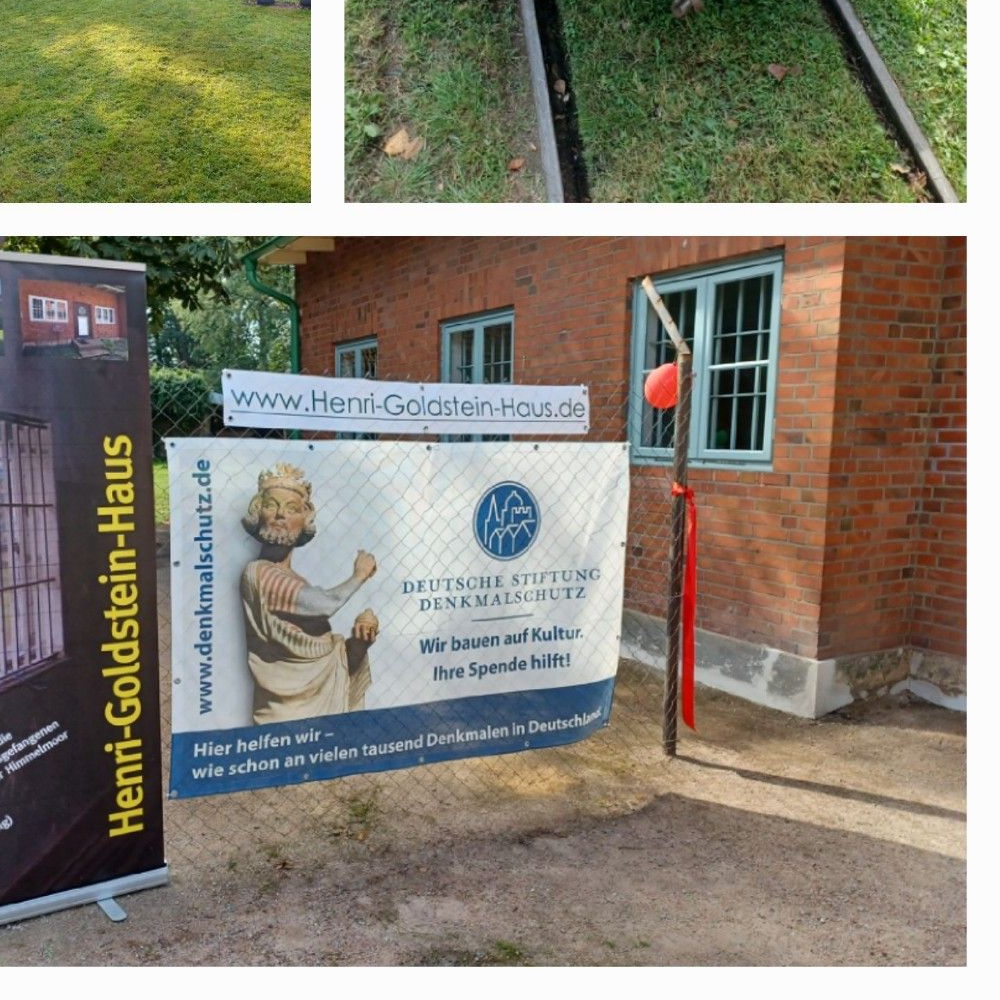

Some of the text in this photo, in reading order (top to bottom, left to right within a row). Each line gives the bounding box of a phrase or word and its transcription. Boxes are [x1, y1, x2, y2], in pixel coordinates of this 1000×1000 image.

[230, 389, 586, 419] www.Henri-Goldstein-Haus.de
[192, 459, 213, 715] www.denkmalschutz.de
[402, 568, 601, 594] DEUTSCHE STIFTUNG
[420, 586, 587, 611] DENKMALSCHUTZ
[97, 434, 144, 838] Henri-Goldstein-Haus
[419, 625, 584, 654] Wir bauen auf Kultur.
[433, 653, 571, 681] Ihre Spende hilft!
[4, 730, 69, 774] Himmelmoor
[192, 763, 224, 780] wie
[228, 757, 280, 776] schon
[284, 755, 304, 768] an
[309, 746, 358, 764] vielen
[362, 734, 423, 757] tausend
[426, 725, 510, 747] Denkmalen
[512, 722, 525, 735] in
[193, 742, 232, 758] Hier
[236, 734, 291, 753] helfen
[295, 728, 322, 744] wir
